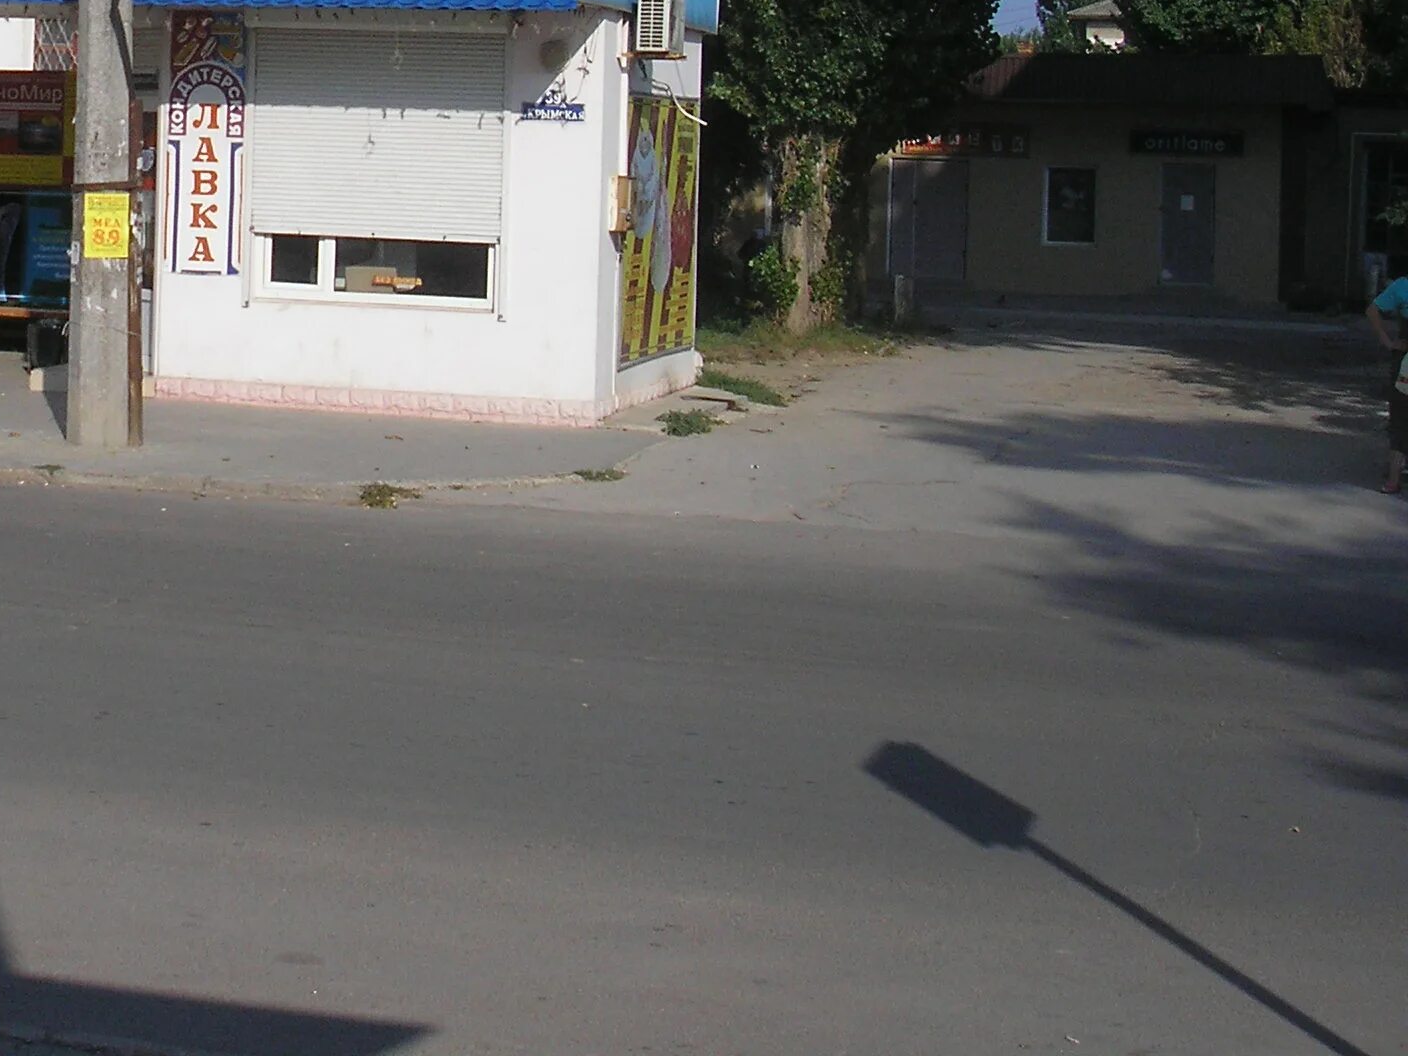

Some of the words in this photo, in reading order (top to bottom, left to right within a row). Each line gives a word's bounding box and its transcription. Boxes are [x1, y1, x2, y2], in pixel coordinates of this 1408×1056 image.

[170, 67, 243, 134] КОНДИТЕРСКАЯ
[544, 89, 562, 105] 39
[187, 103, 220, 262] ЛАВКА
